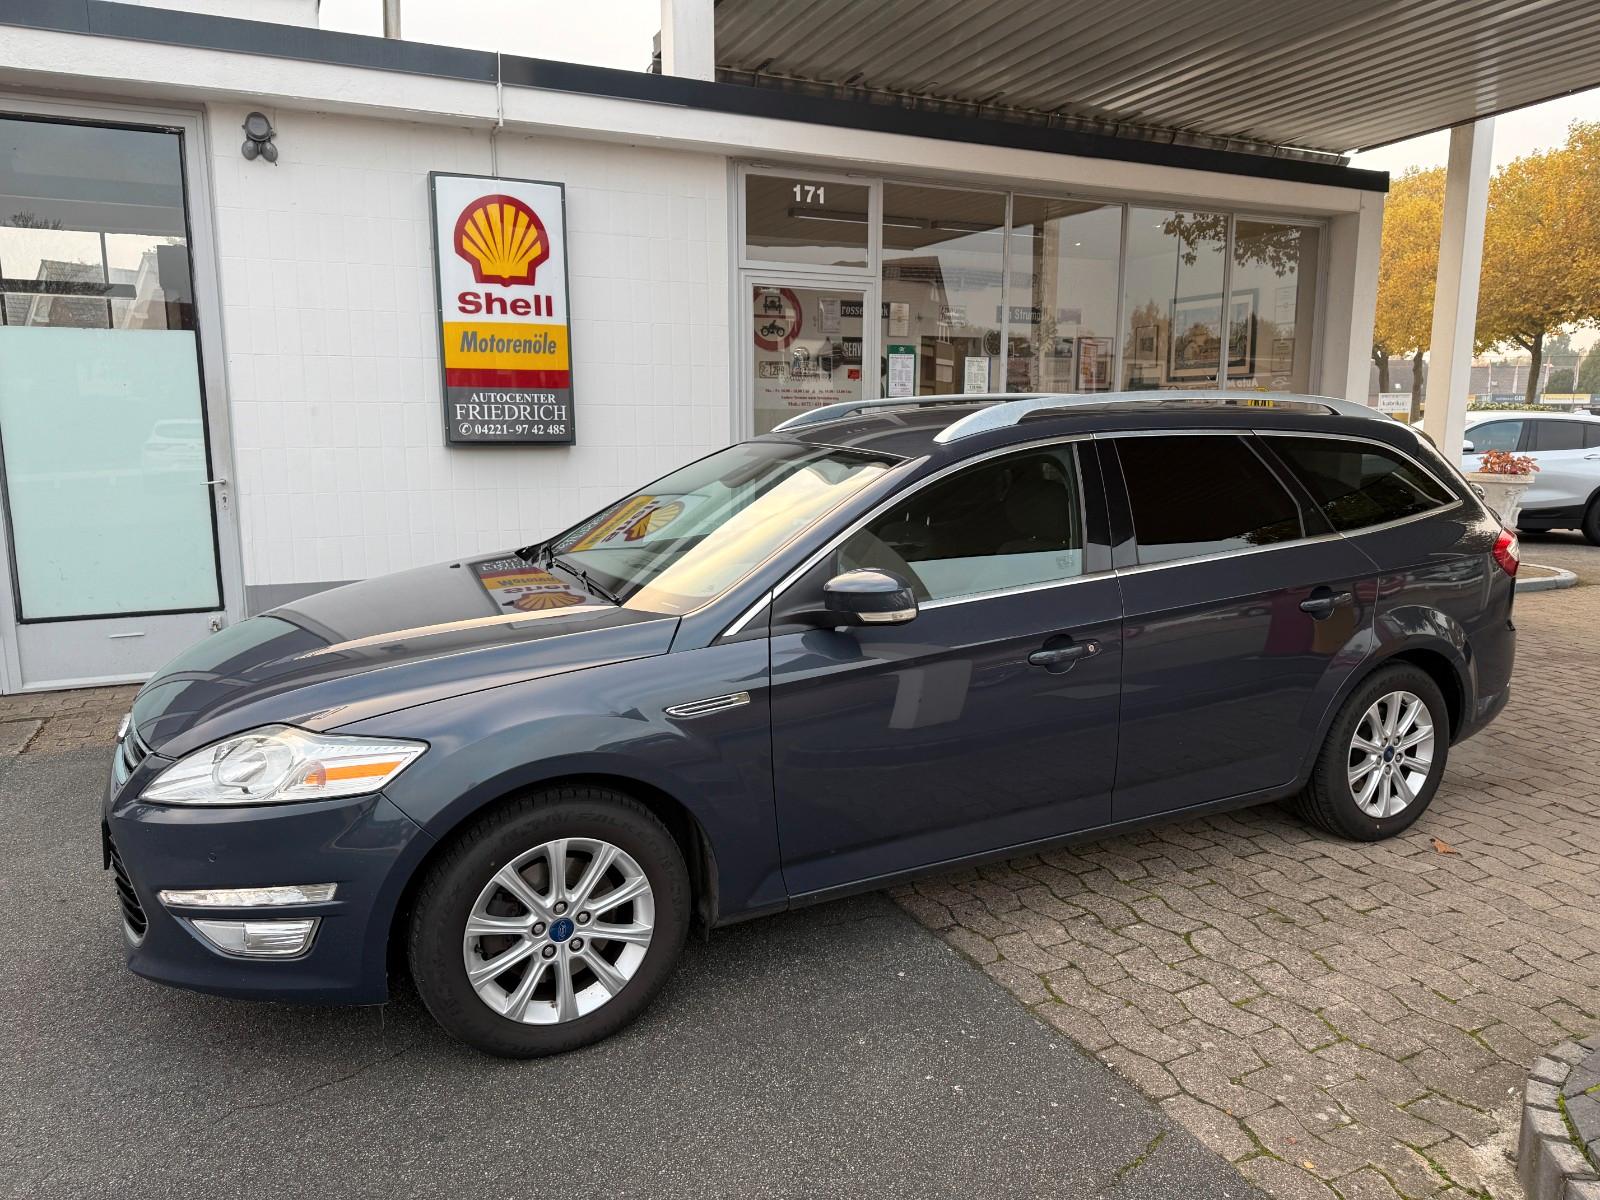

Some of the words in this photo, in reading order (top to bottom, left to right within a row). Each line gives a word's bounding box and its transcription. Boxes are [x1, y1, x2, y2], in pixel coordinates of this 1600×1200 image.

[793, 184, 825, 204] 171
[457, 291, 553, 317] Shell
[460, 330, 557, 355] Motorenöle
[470, 392, 556, 404] AUTOCENTER
[454, 404, 567, 421] FRIEDRICH
[531, 424, 544, 435] 42
[546, 424, 566, 435] 485
